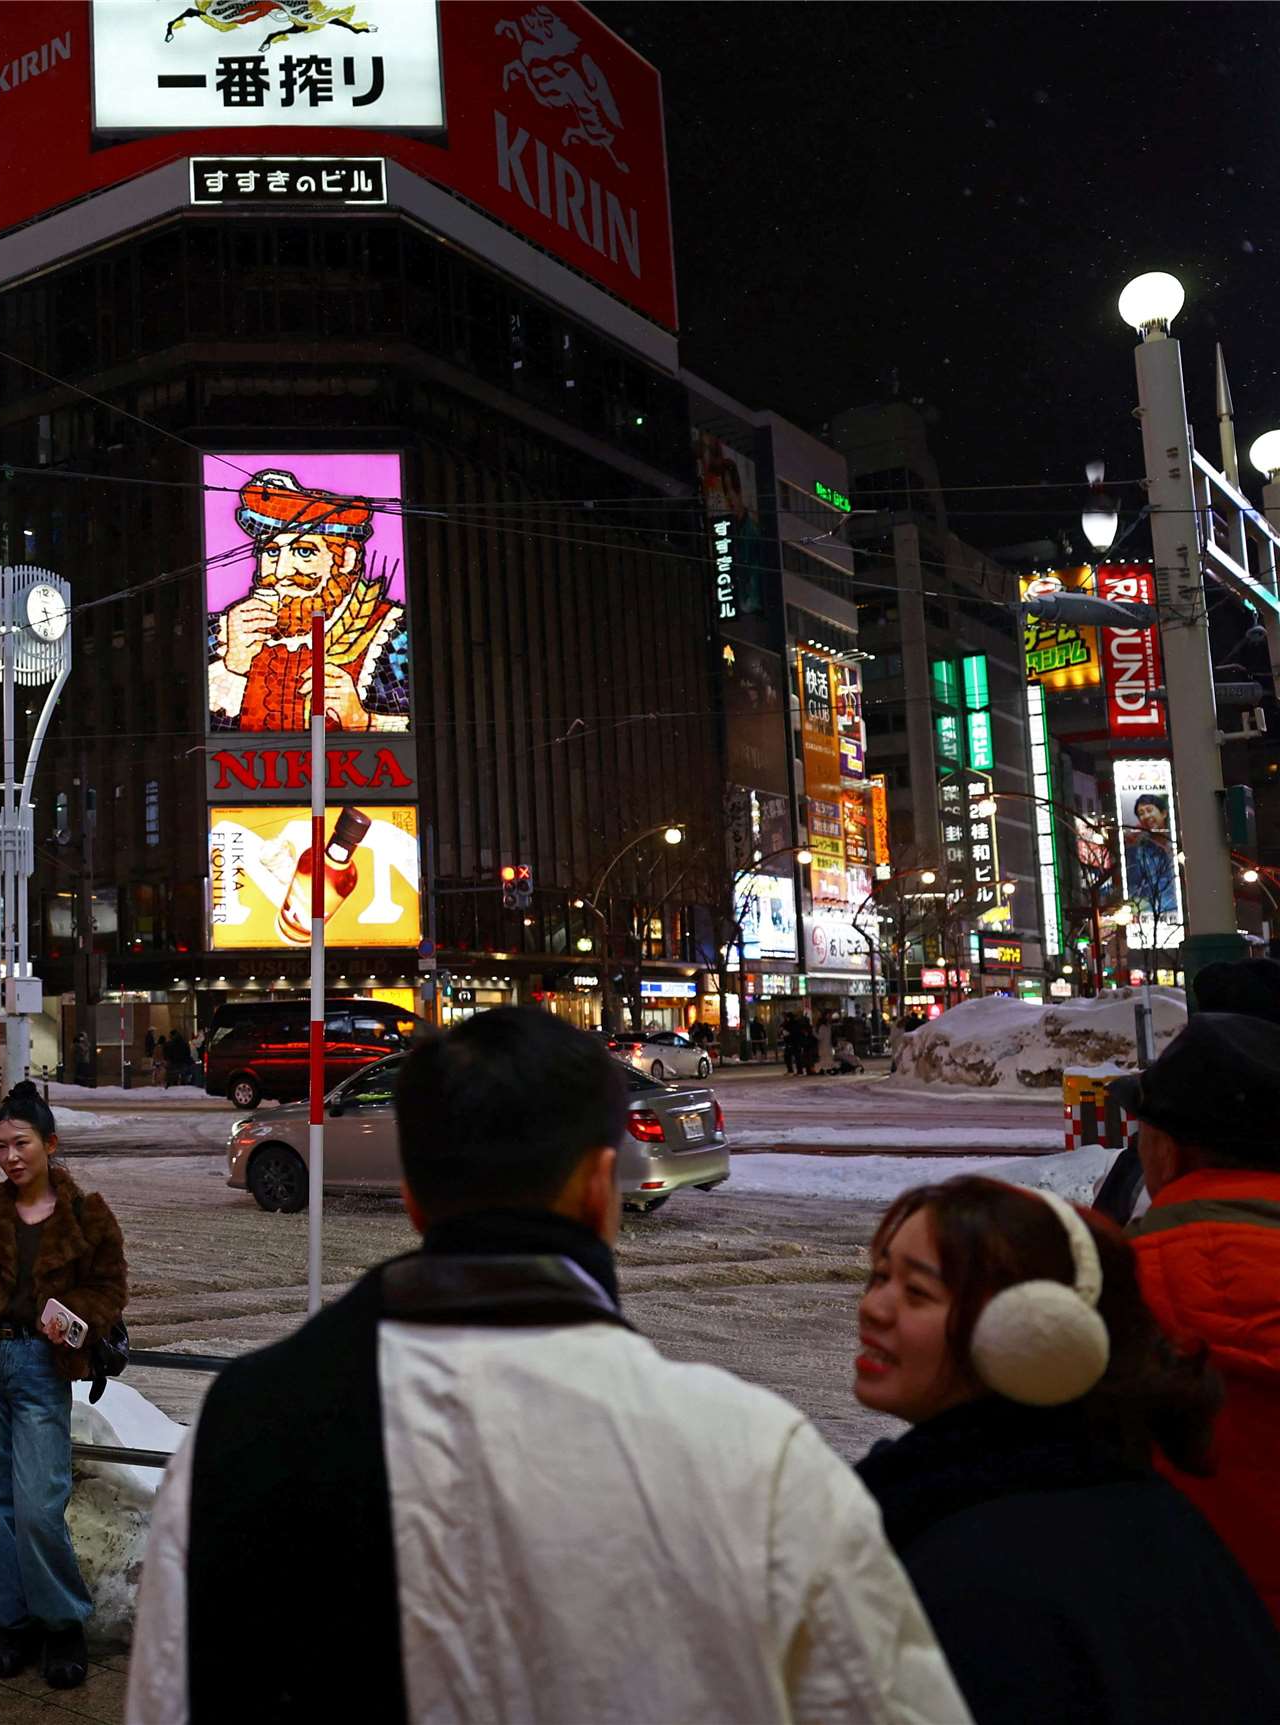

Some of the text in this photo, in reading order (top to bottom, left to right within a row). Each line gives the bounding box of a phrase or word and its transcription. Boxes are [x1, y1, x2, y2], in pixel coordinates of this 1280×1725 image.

[157, 54, 387, 108] 一番搾り
[204, 170, 373, 193] すすきのビル
[493, 111, 641, 278] KIRIN
[714, 520, 736, 618] すすきのビル
[806, 667, 829, 699] 快活
[808, 700, 830, 722] CLUB
[210, 748, 414, 789] NIKKA
[232, 833, 246, 892] NIKKA
[968, 782, 993, 904] 第2桂和ビル
[212, 833, 227, 924] FRONTIER
[239, 958, 341, 976] SUSUKO
